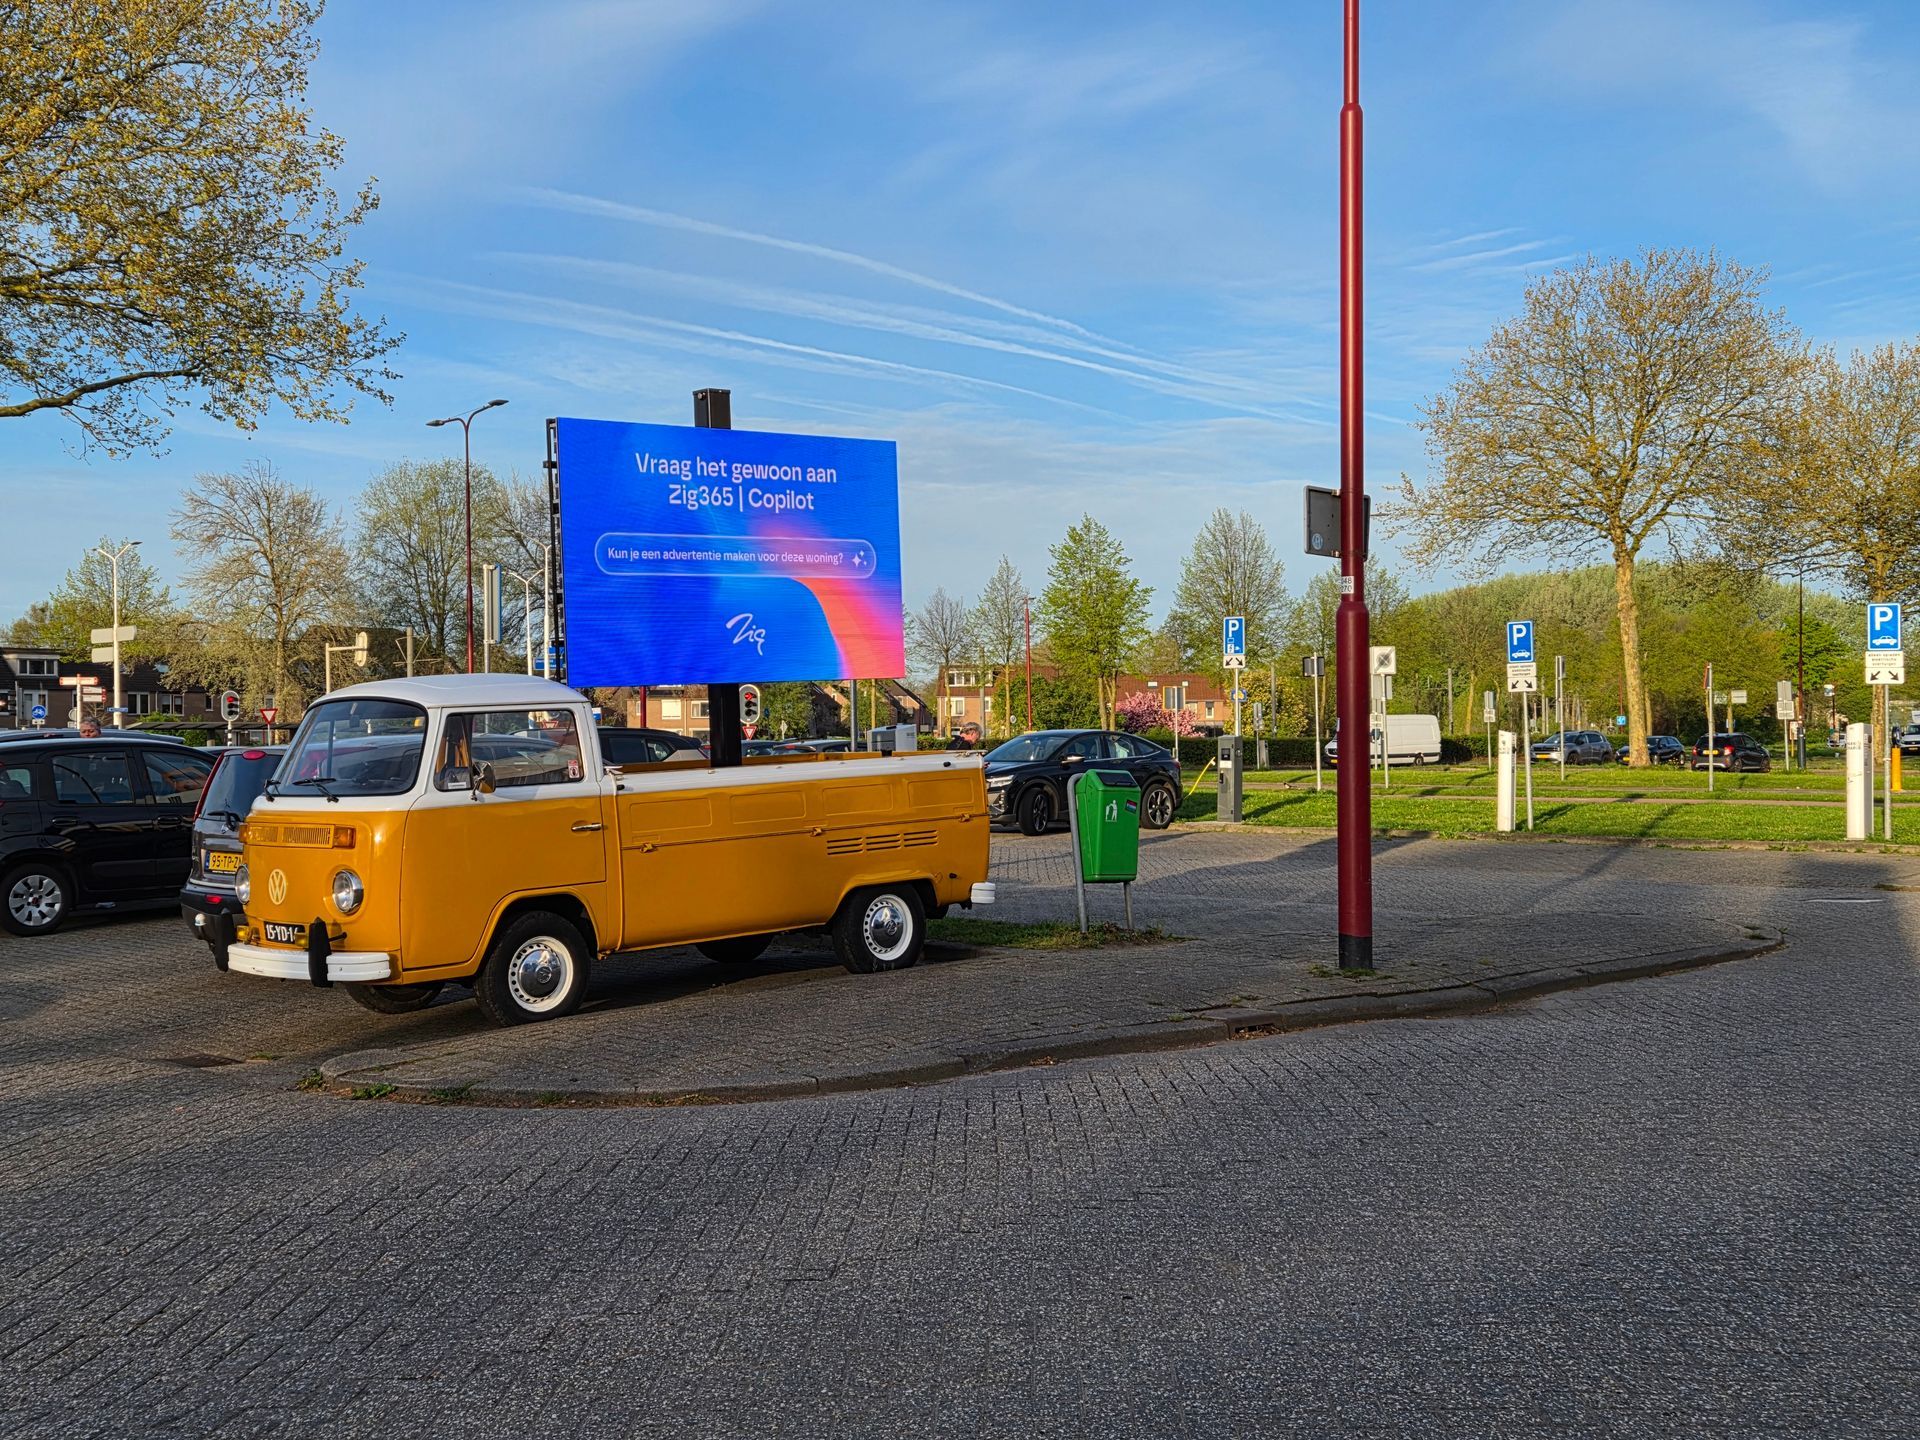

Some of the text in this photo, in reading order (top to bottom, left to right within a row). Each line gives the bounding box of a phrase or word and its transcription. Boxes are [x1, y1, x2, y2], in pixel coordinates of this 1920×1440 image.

[635, 452, 837, 483] Vraag het gewoon aan
[668, 484, 734, 510] Zig365
[748, 487, 815, 514] Copilot
[608, 547, 844, 565] Kun je een advertentie maken voor deze woning?
[1228, 619, 1240, 638] P
[1873, 606, 1893, 631] P
[1512, 624, 1527, 646] P
